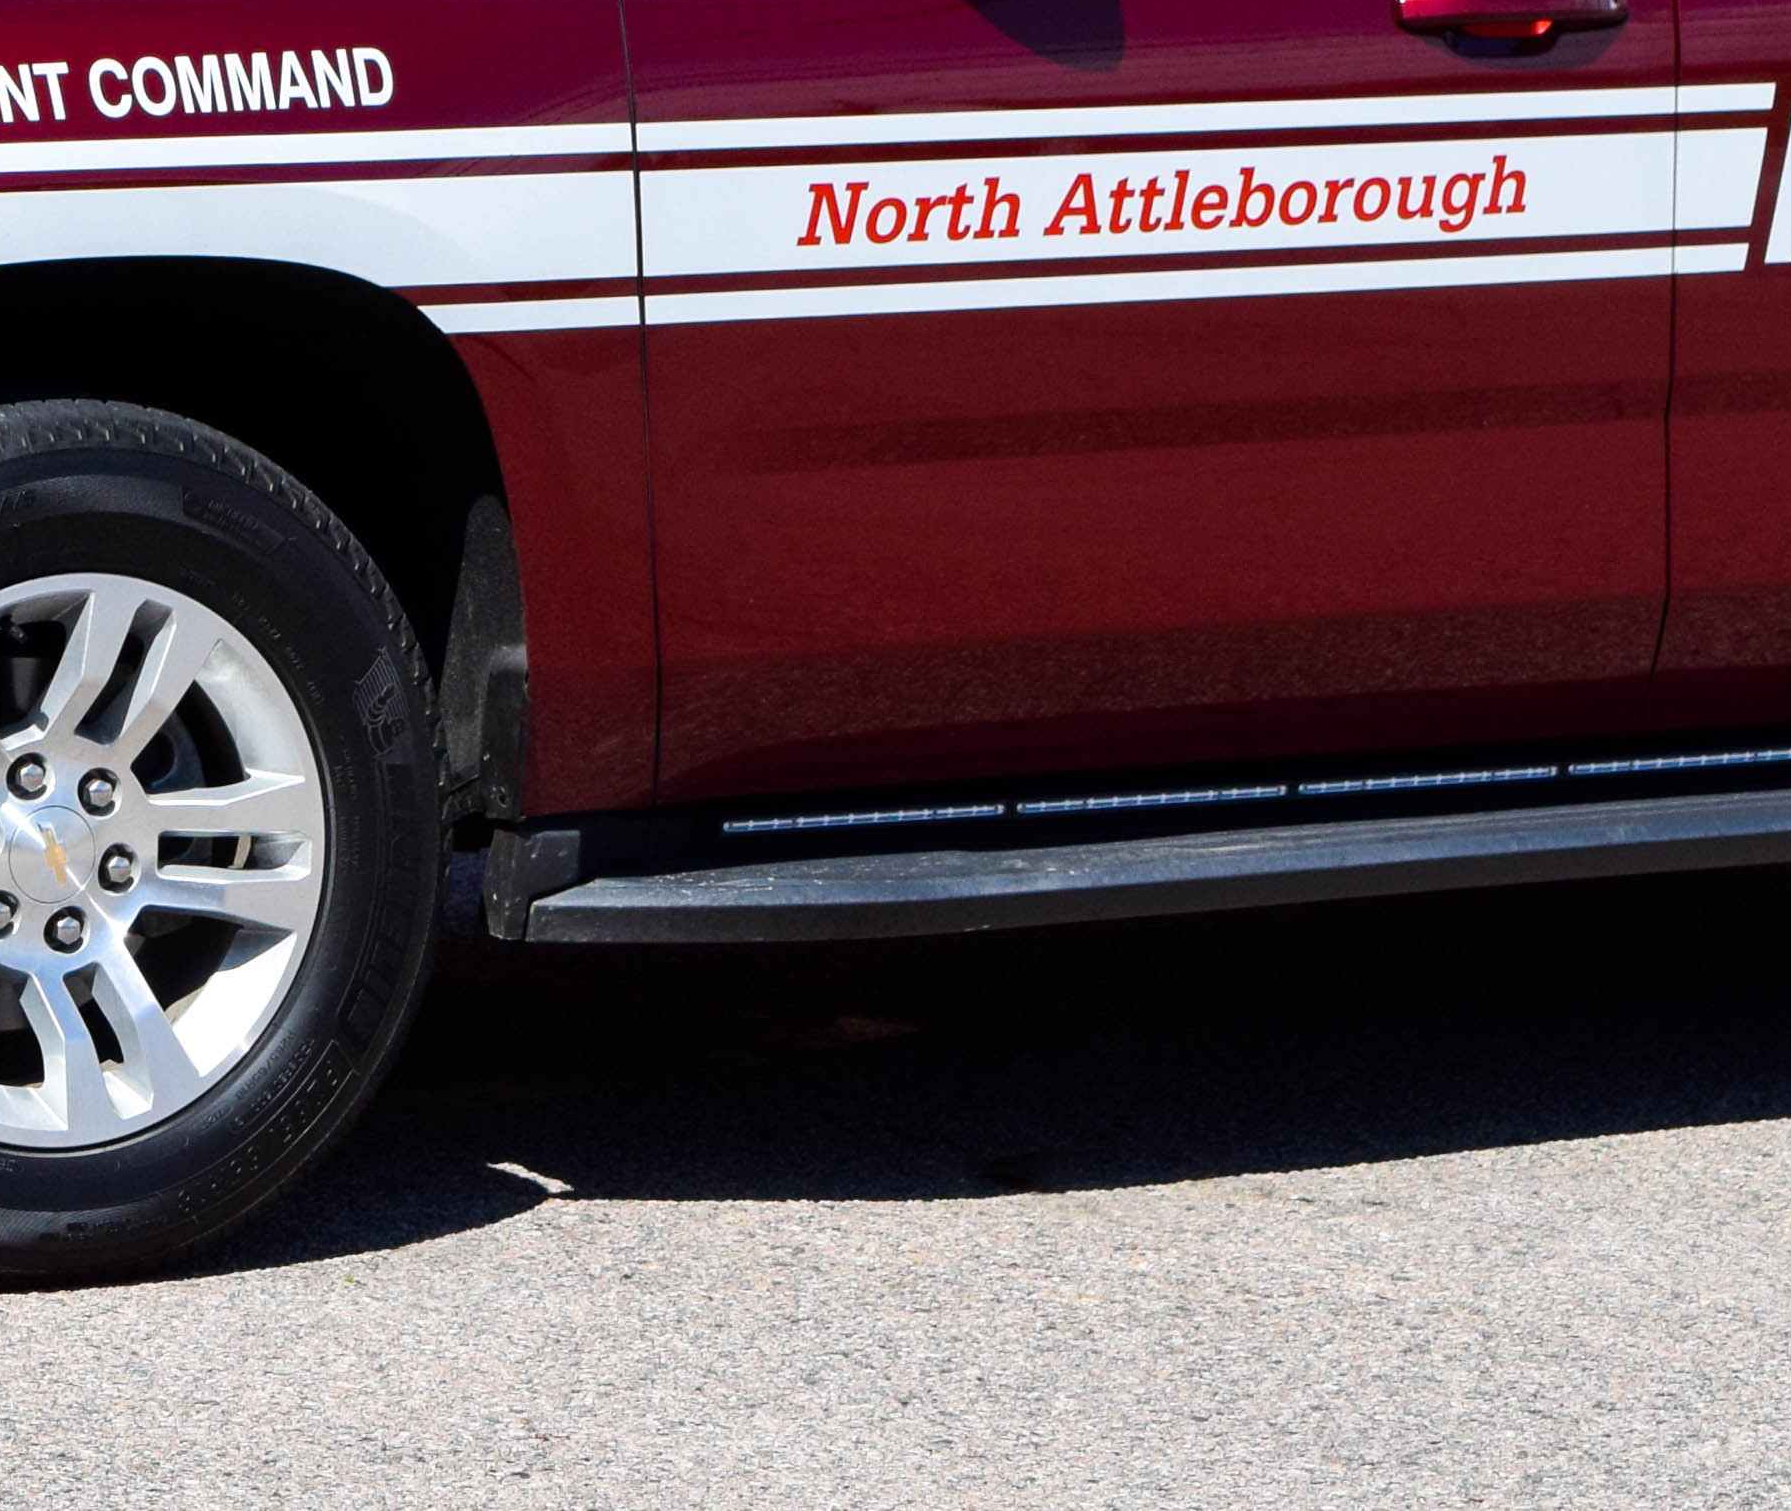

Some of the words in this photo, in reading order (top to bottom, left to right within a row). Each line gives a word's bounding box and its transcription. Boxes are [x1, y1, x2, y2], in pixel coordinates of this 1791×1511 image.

[88, 47, 394, 119] COMMAND
[797, 177, 1021, 246] North
[1044, 155, 1527, 236] Attleborough
